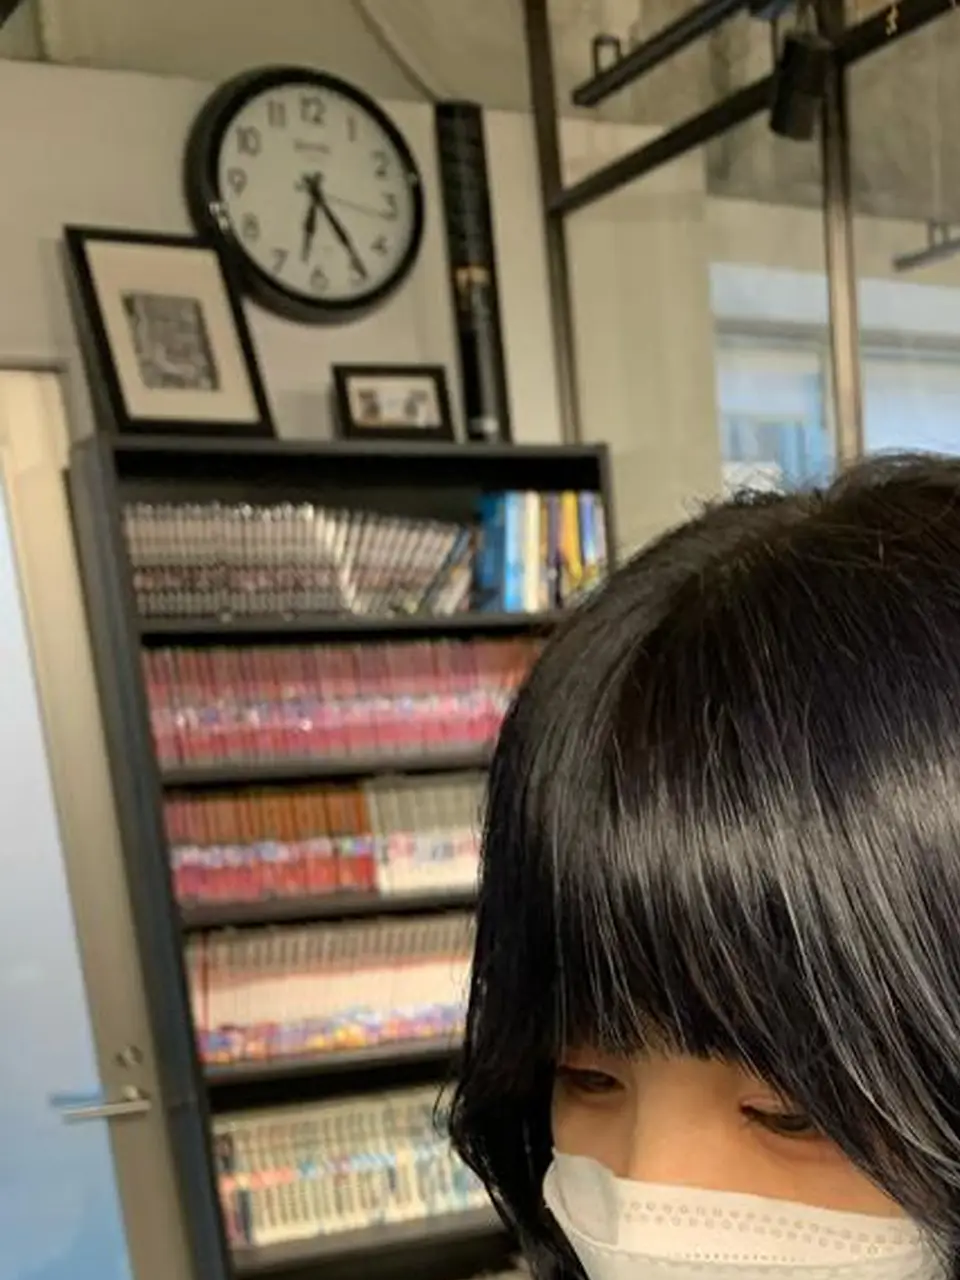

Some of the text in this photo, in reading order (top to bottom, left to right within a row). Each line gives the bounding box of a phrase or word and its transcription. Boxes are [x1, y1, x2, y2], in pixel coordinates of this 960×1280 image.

[300, 95, 326, 126] 12
[236, 125, 262, 157] 10
[346, 115, 358, 142] 1
[370, 149, 391, 180] 2
[227, 167, 248, 197] 9
[380, 191, 398, 220] 3
[241, 211, 262, 244] 8
[270, 246, 290, 275] 7
[370, 234, 389, 258] 4
[309, 264, 330, 292] 6
